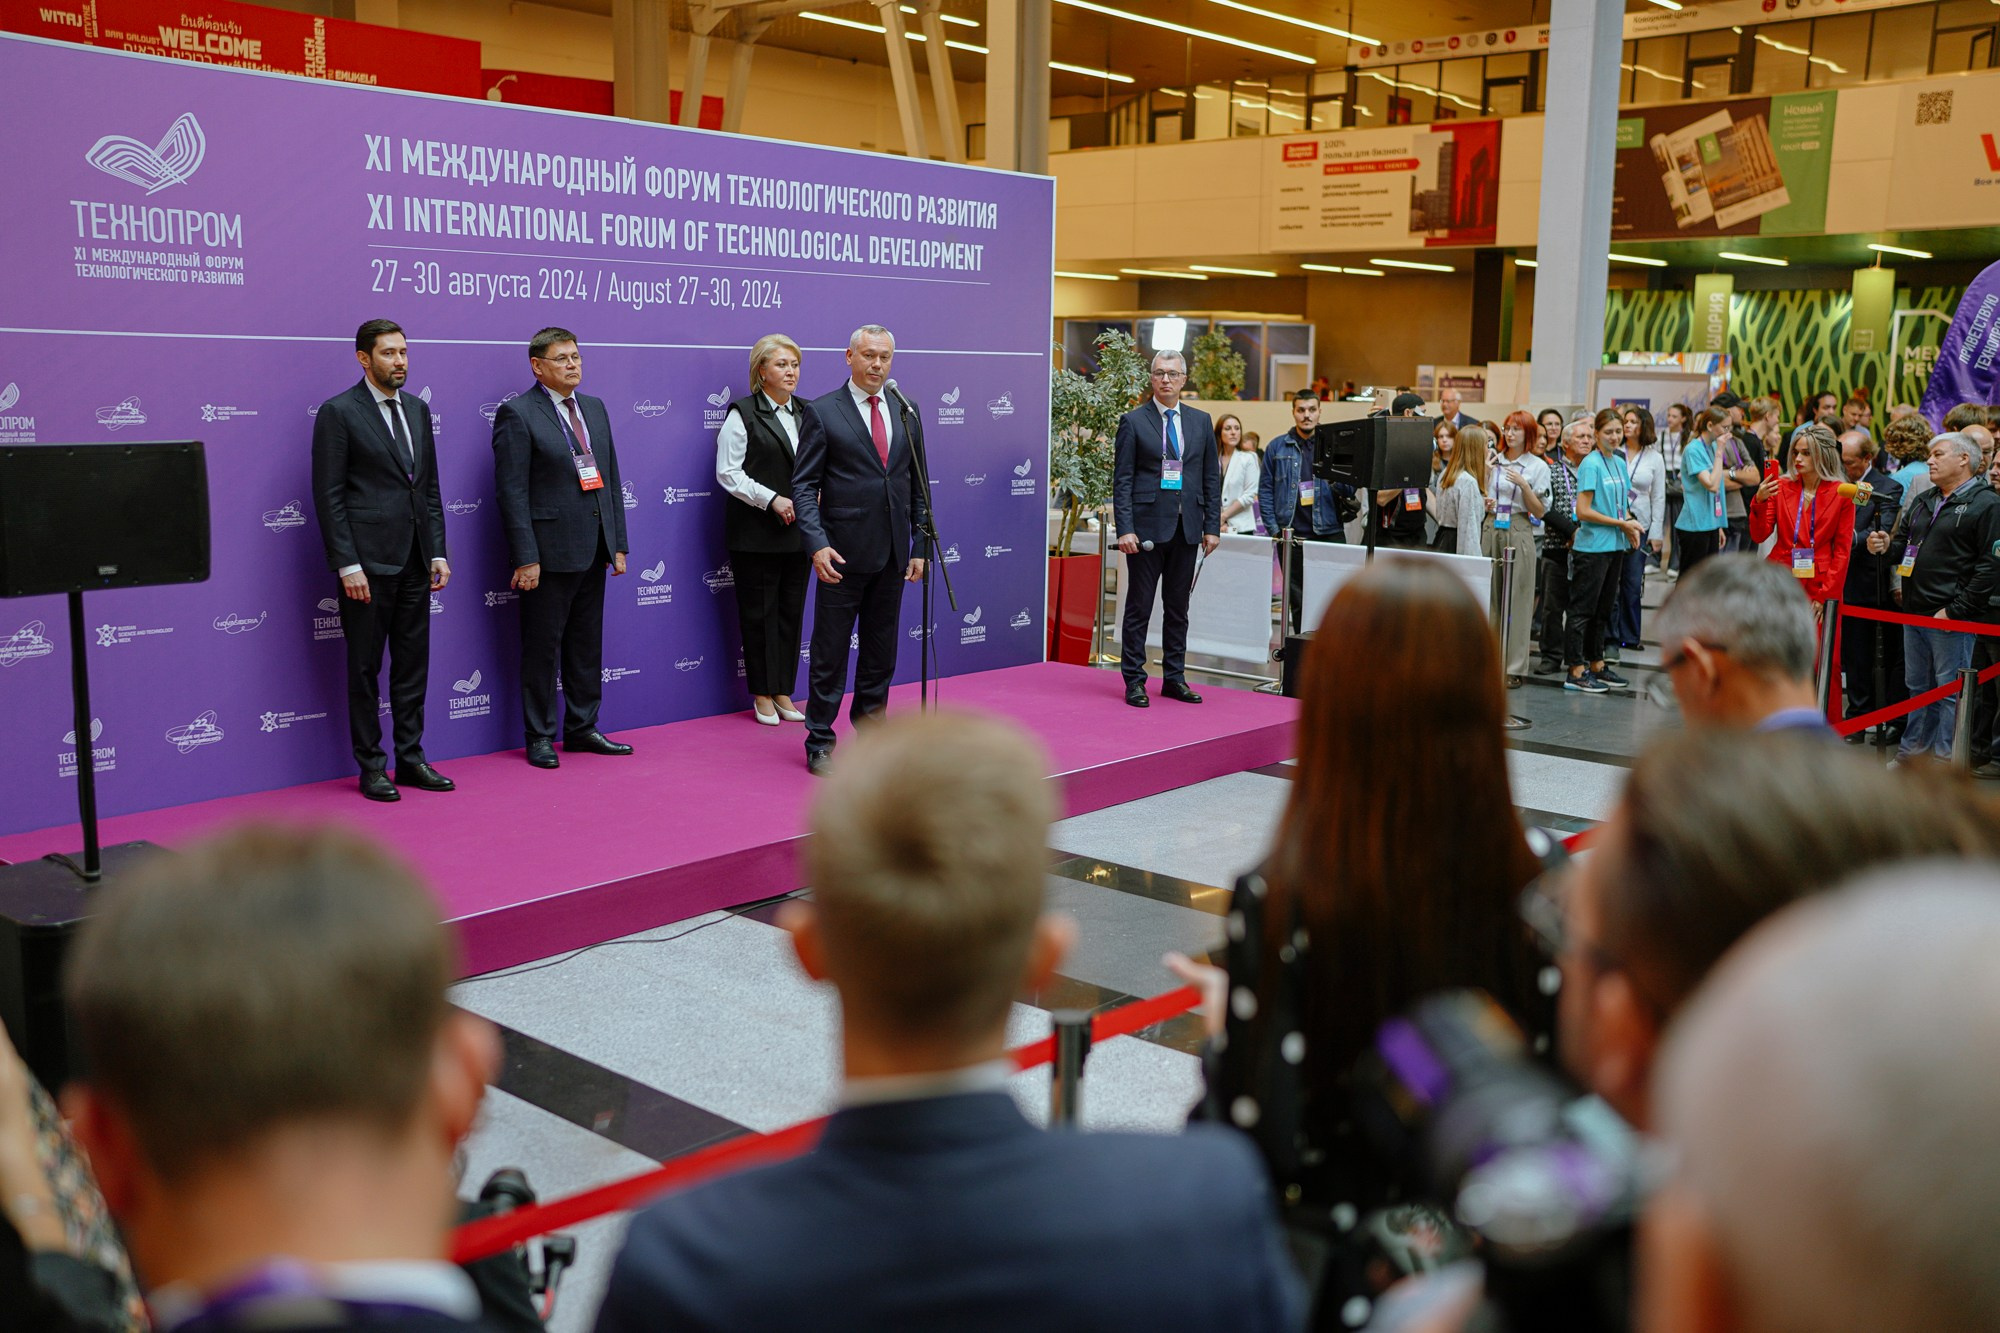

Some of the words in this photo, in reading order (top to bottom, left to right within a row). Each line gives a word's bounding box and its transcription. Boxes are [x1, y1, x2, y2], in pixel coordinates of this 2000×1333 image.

[39, 7, 83, 28] WITAJ
[158, 25, 262, 61] WELCOME
[1323, 140, 1346, 149] 100%
[1371, 147, 1408, 156] бизнеса
[364, 133, 392, 172] XI
[401, 137, 638, 196] МЕЖДУНАРОДНЫЙ
[645, 165, 720, 203] ФОРУМ
[726, 173, 912, 222] ТЕХНОЛОГИЧЕСКОГО
[917, 195, 998, 230] РАЗВИТИЯ
[70, 200, 243, 249] ТЕХНОПРОМ
[366, 193, 393, 230] XI
[403, 196, 594, 244] INTERNATIONAL
[601, 212, 676, 250] FORUM
[683, 220, 709, 252] OF
[715, 222, 864, 263] TECHNOLOGICAL
[869, 235, 984, 271] DEVELOPMENT
[74, 246, 87, 260] XI
[91, 247, 200, 268] МЕЖДУНАРОДНЫЙ
[205, 255, 244, 270] ФОРУМ
[75, 263, 188, 283] ТЕХНОЛОГИЧЕСКОГО
[191, 270, 244, 286] РАЗВИТИЯ
[448, 271, 531, 305] августа
[538, 267, 588, 301] 2024
[608, 271, 672, 311] August
[741, 278, 782, 309] 2024
[1705, 292, 1725, 349] ШОРИЯ
[1958, 293, 2000, 365] ПРИВЕТСТВУЮ
[1974, 318, 2000, 371] ТЕХНОПР
[121, 402, 133, 410] 22
[637, 584, 672, 596] TECHNOPROM
[18, 629, 34, 639] 22
[31, 635, 43, 644] 31
[146, 627, 174, 635] TECHNOLOGY
[194, 718, 208, 727] 22
[303, 712, 327, 720] TECHNOLOGY
[58, 746, 116, 765] TECHPROM
